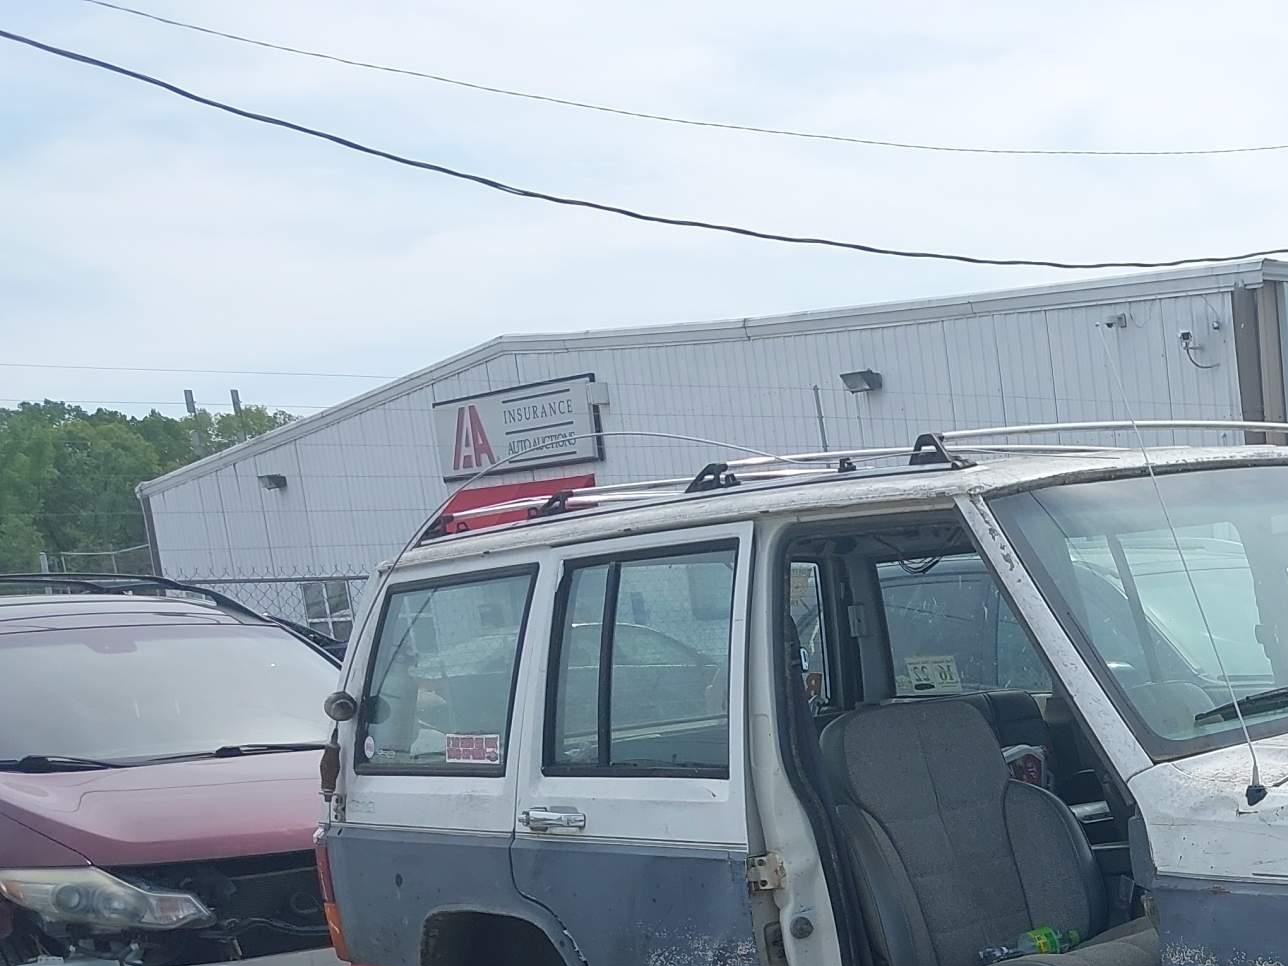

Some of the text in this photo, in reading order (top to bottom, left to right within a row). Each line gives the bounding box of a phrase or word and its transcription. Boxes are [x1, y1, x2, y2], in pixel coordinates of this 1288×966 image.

[503, 399, 573, 424] INSURANCE
[508, 431, 577, 456] AUTO AUCTIONS
